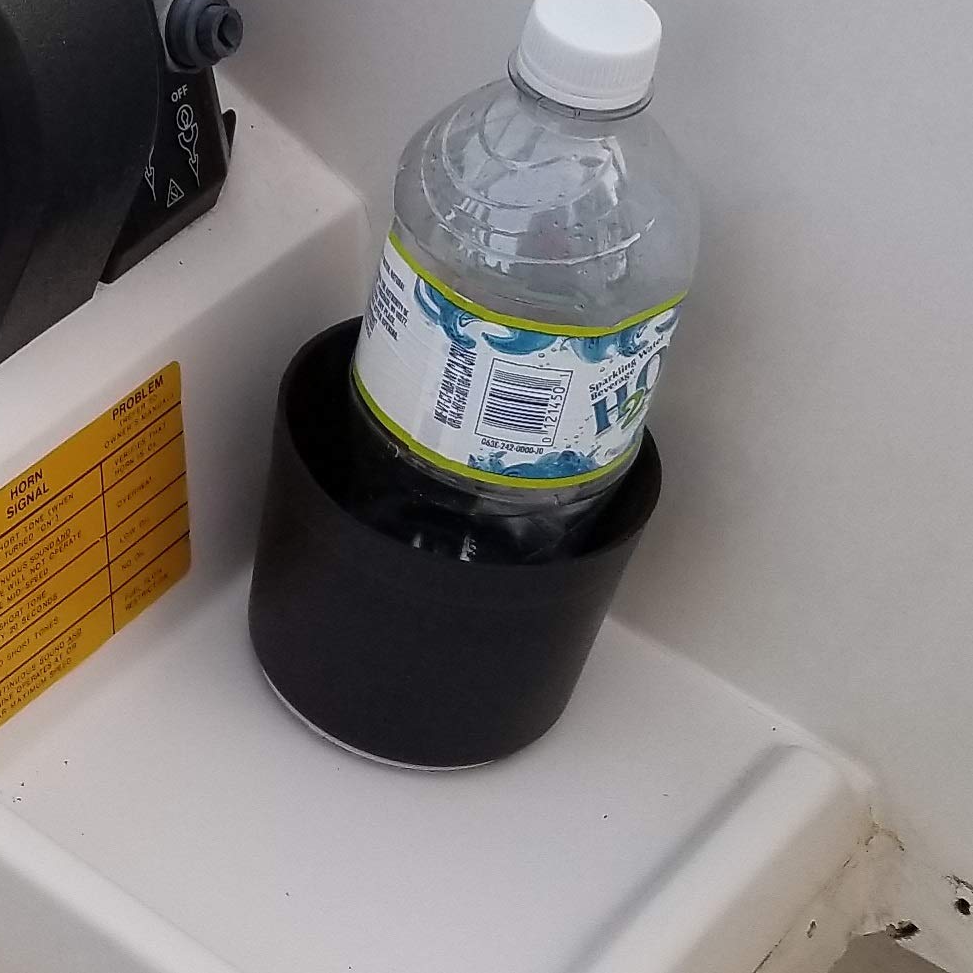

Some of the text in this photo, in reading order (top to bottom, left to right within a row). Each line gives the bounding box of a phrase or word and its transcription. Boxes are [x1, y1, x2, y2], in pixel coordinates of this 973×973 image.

[170, 84, 189, 104] OFF
[588, 334, 665, 392] Sparkling Water
[111, 375, 164, 420] PROBLEM
[590, 366, 635, 401] Beverage
[543, 386, 566, 429] 121450
[6, 481, 49, 520] SIGNAL
[9, 468, 43, 500] HORN
[24, 513, 44, 533] TONE
[4, 531, 34, 559] TURNED
[29, 540, 54, 564] SOUND
[55, 527, 71, 545] AND
[29, 557, 46, 575] NOT
[48, 529, 82, 560] OPERATE
[21, 591, 58, 625] SECONDS
[39, 640, 65, 665] SOUND
